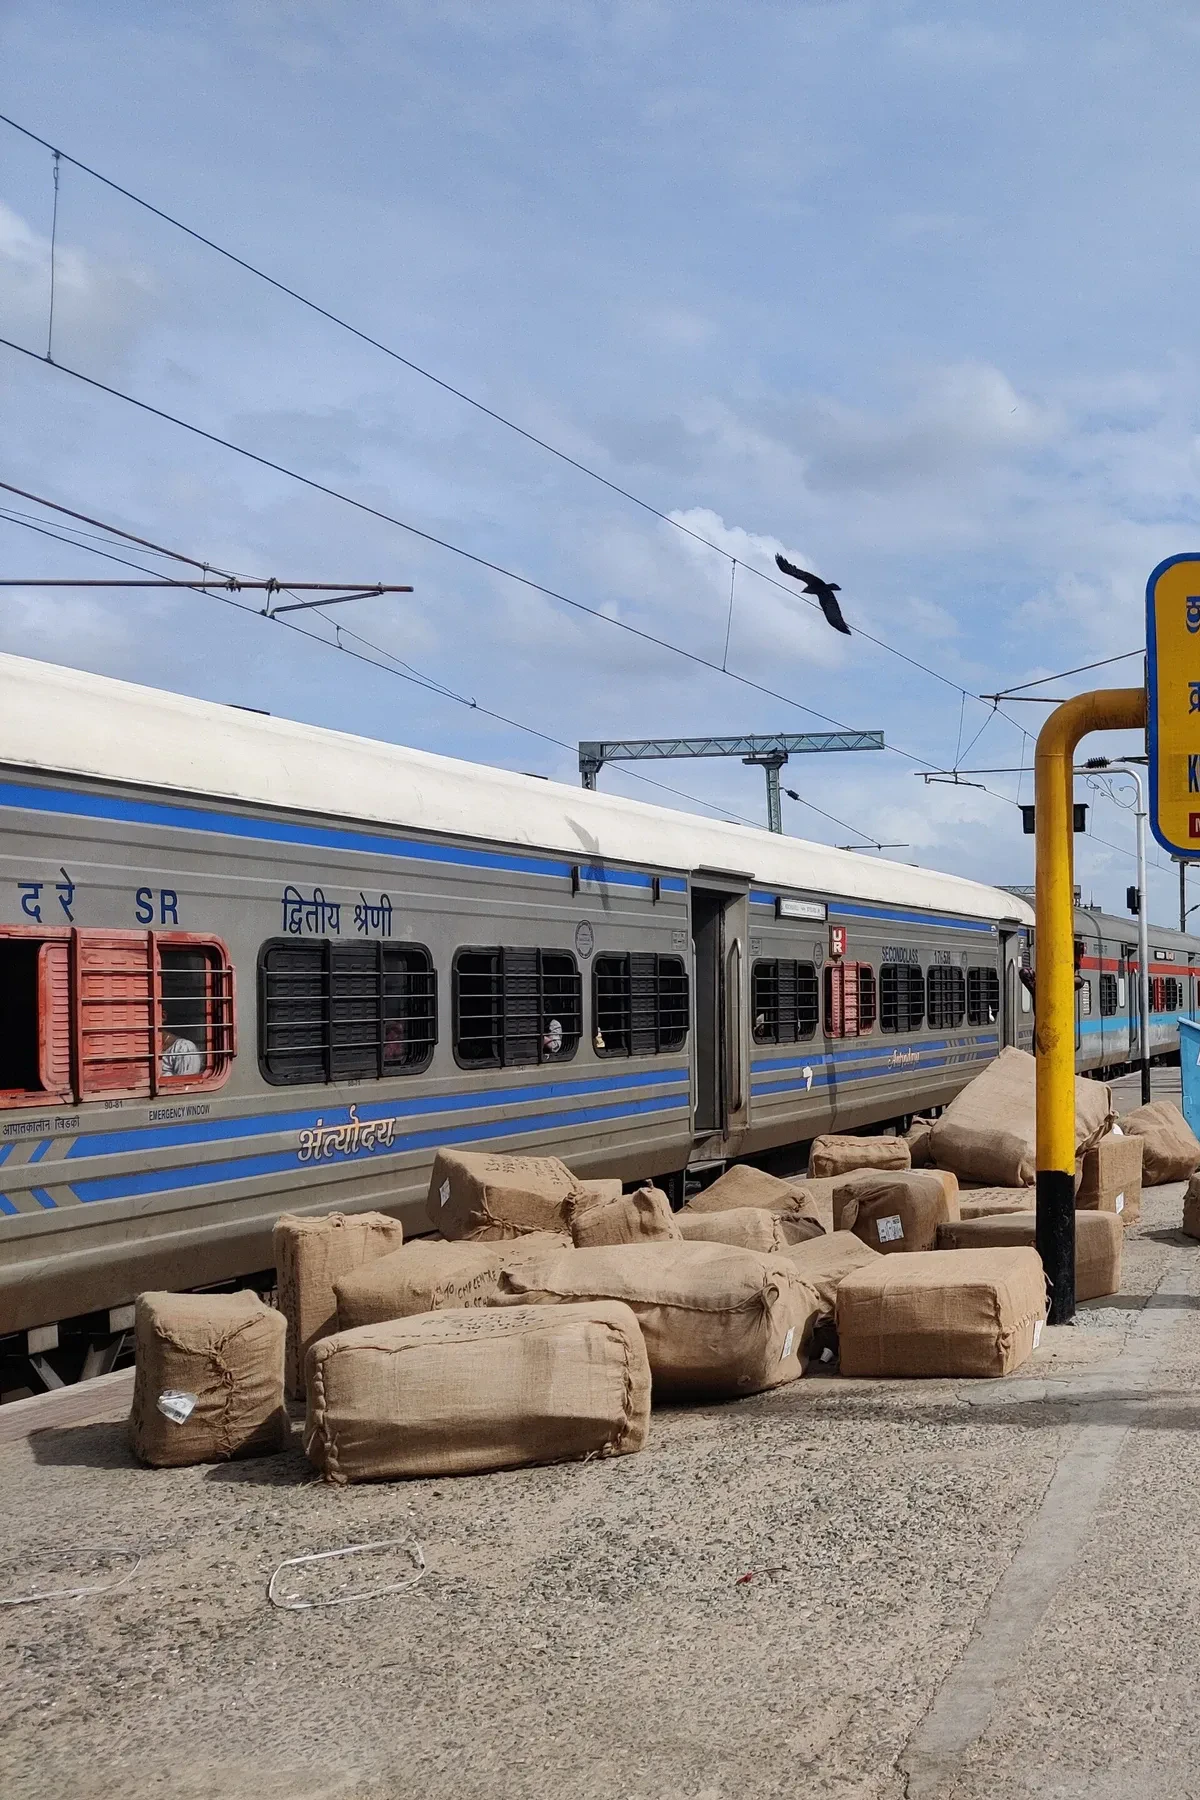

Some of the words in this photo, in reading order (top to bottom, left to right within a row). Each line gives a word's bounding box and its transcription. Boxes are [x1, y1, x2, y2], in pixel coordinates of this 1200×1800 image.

[135, 887, 179, 925] SR
[281, 885, 341, 935] द्वितीय
[353, 892, 393, 937] श्रेणी
[833, 929, 842, 953] UR
[104, 1100, 123, 1110] 90-81
[149, 1107, 185, 1121] EMERGENCY
[185, 1104, 211, 1116] WINDOW
[297, 1103, 397, 1161] अंत्योदय
